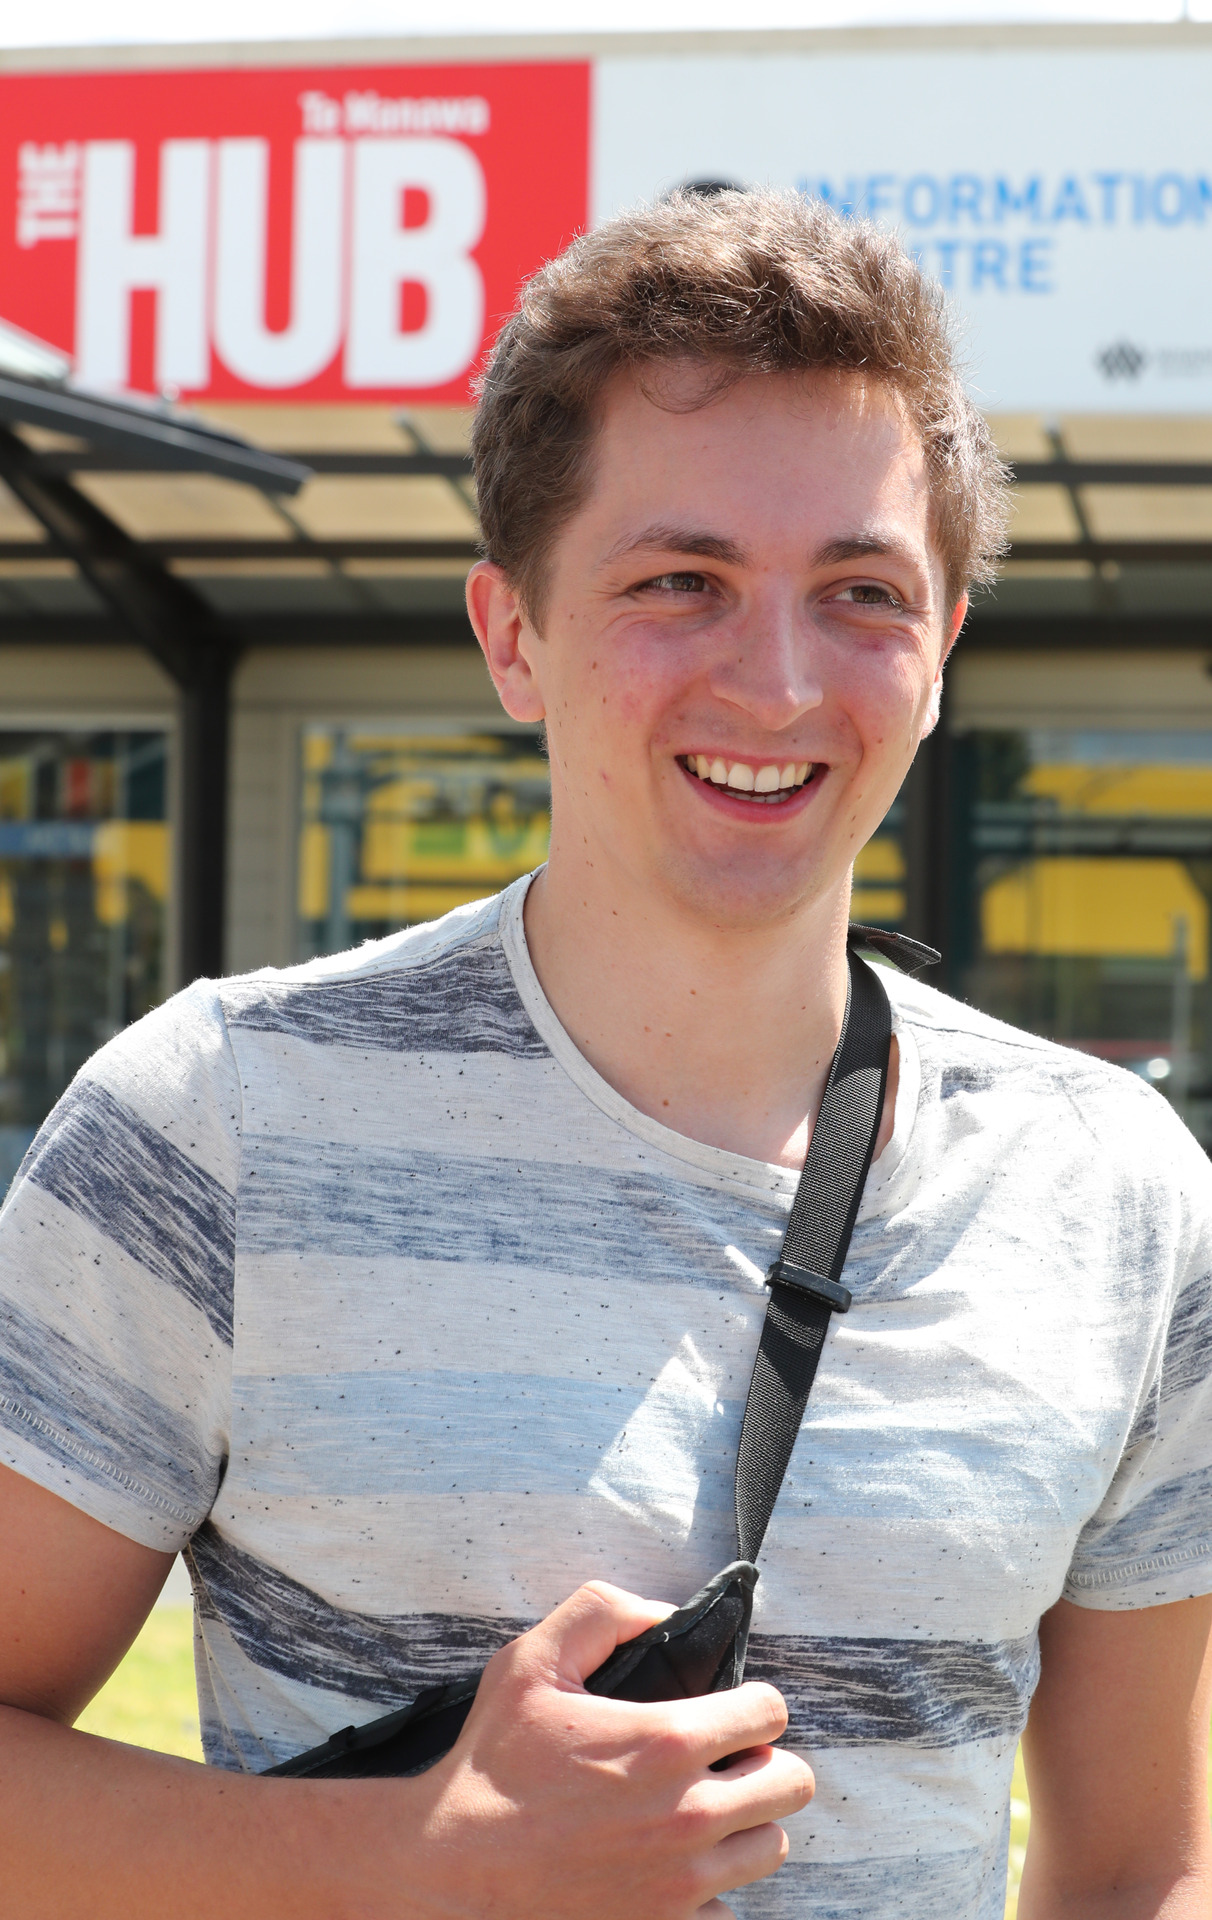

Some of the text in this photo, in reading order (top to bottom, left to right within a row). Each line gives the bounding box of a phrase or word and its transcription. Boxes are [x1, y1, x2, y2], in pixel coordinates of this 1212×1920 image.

[17, 140, 78, 248] THE
[77, 138, 486, 390] HUB
[911, 237, 1055, 293] TRE
